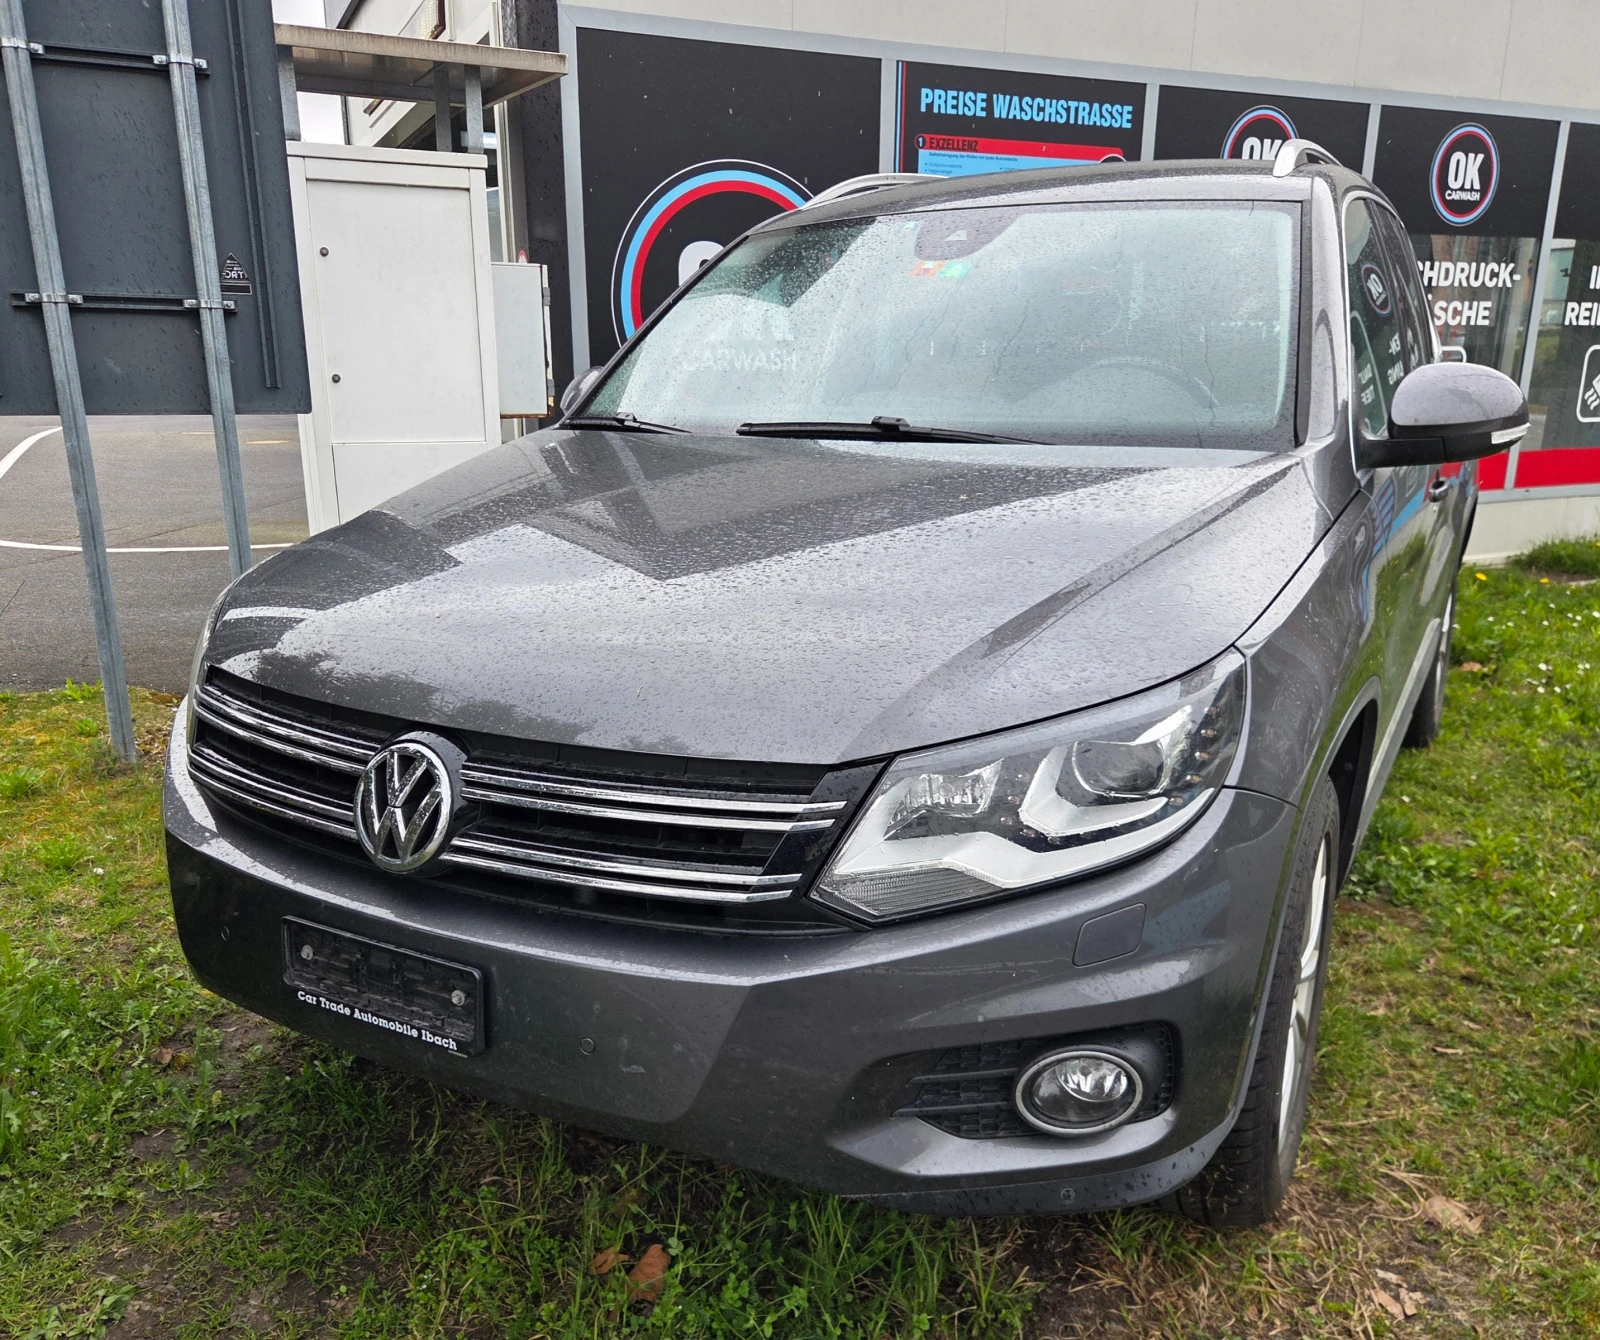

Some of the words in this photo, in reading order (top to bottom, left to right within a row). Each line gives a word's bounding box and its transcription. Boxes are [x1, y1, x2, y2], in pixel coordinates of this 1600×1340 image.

[920, 87, 987, 117] PREISE
[993, 93, 1133, 129] WASCHSTRASSE
[929, 137, 979, 152] EXZELLENZ
[1448, 151, 1485, 189] OK
[1445, 190, 1481, 201] CARWASH
[1417, 260, 1521, 288] HDRUCK-
[1429, 294, 1492, 326] SCHE
[1564, 301, 1600, 326] REI
[297, 990, 317, 1005] Car
[319, 997, 351, 1016] Trade
[353, 1008, 419, 1038] Automobile
[421, 1029, 458, 1051] Ibach
